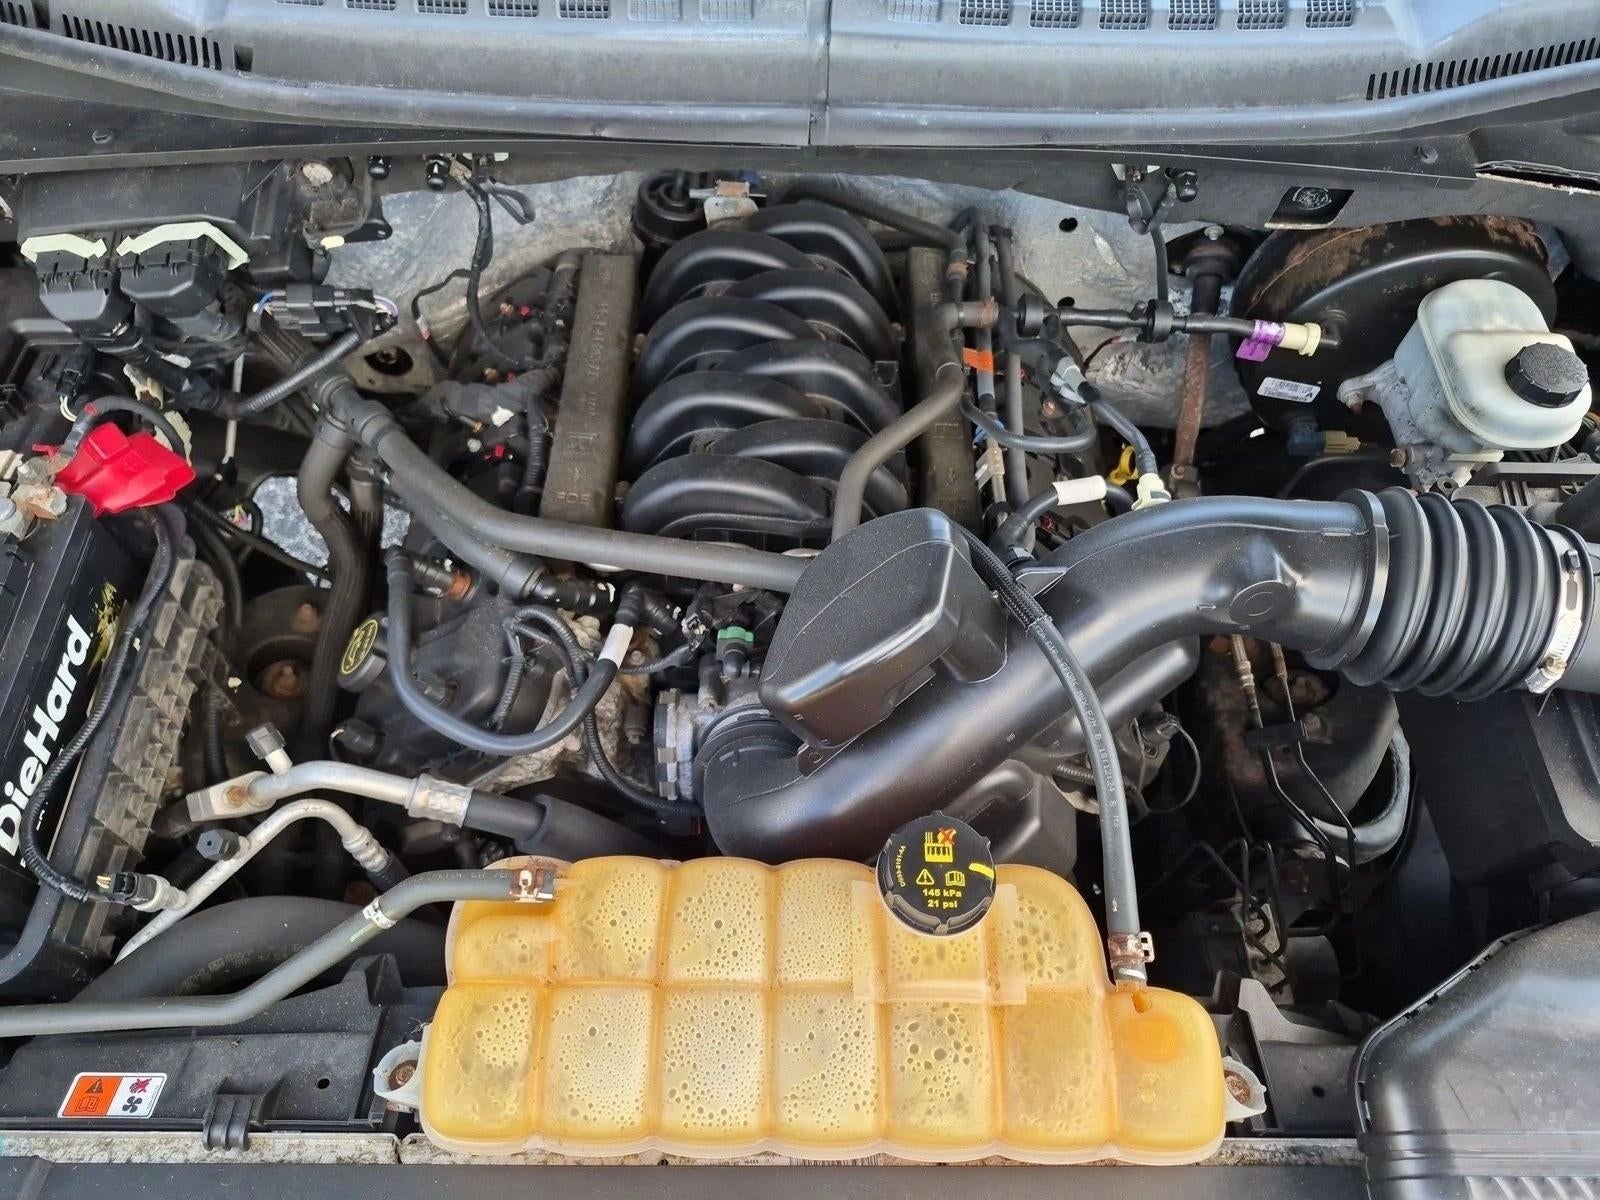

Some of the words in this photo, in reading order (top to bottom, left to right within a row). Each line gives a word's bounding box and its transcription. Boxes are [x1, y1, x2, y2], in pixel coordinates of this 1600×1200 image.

[0, 614, 92, 856] DieHard
[922, 888, 940, 898] 145
[943, 888, 962, 898] kPa
[927, 900, 940, 909] 21
[943, 901, 958, 910] psi
